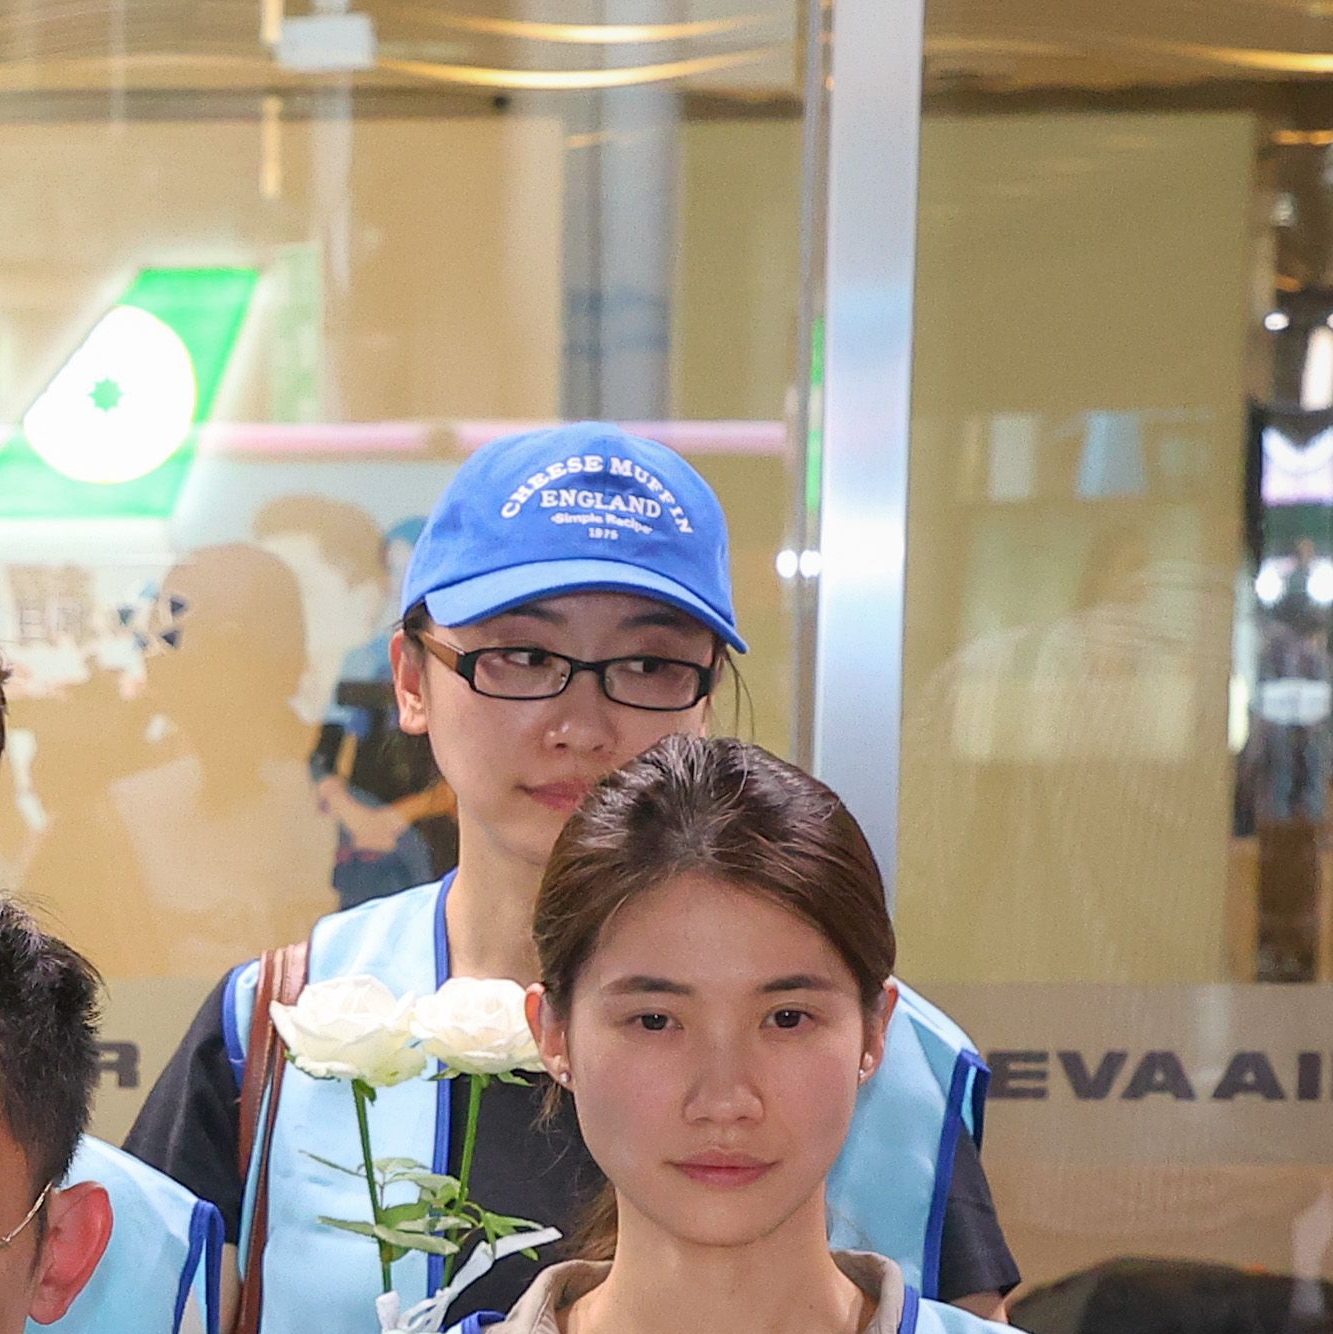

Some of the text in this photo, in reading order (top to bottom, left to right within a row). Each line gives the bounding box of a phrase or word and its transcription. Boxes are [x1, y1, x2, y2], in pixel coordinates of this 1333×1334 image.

[501, 455, 604, 519] CHEESE
[539, 489, 663, 519] ENGLAND
[986, 1050, 1333, 1101] EVA AI
